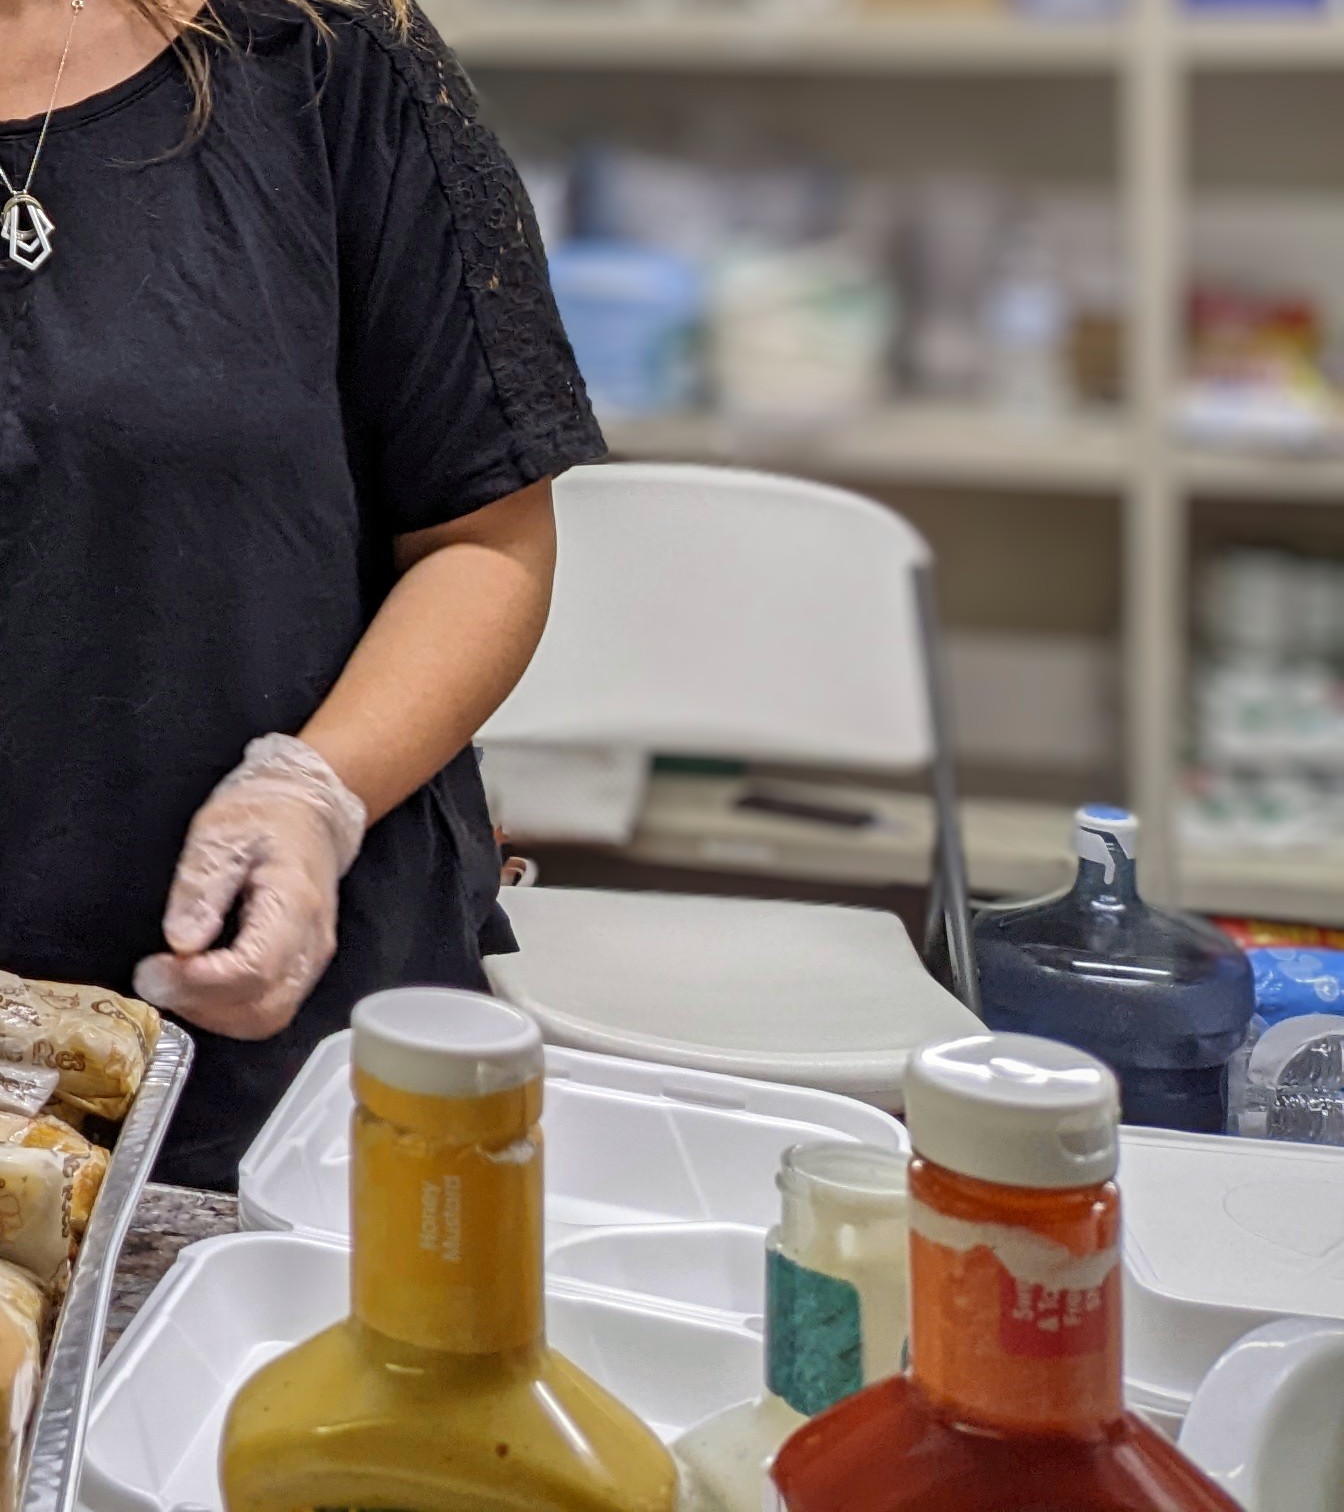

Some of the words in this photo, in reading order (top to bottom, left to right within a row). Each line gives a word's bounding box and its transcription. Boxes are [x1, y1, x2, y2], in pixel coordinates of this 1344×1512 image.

[32, 1038, 87, 1072] Res
[420, 1179, 440, 1250] Honey
[441, 1175, 461, 1262] Mustard
